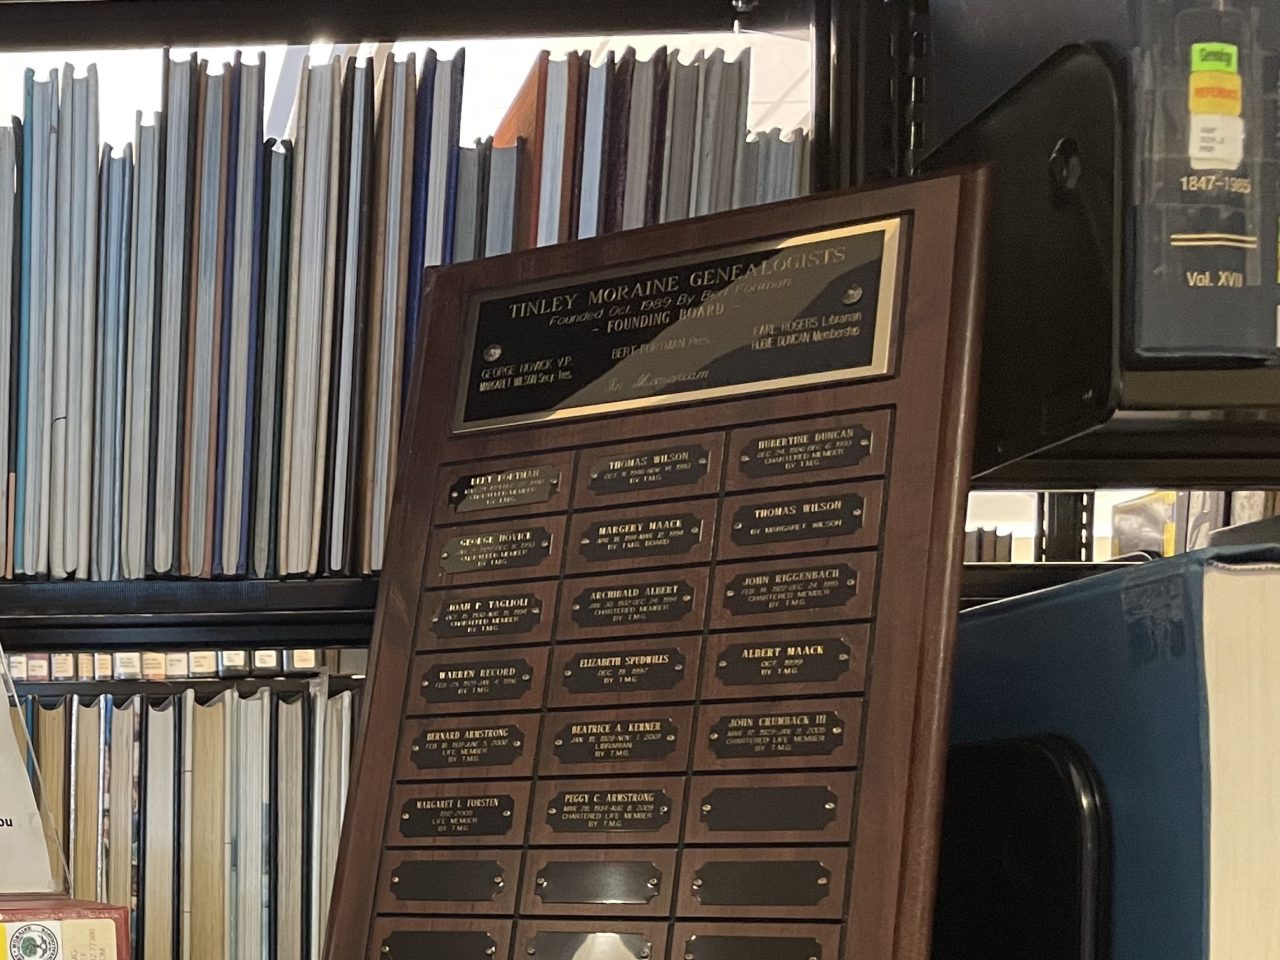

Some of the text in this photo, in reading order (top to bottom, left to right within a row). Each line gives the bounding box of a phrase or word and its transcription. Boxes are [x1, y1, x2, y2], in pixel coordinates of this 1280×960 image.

[509, 246, 847, 319] TINLEY MORAINE GENEALOGISTS
[548, 308, 604, 327] Founded
[640, 298, 672, 311] 1989
[676, 293, 696, 306] By
[607, 303, 725, 334] FOUNDING BOARD
